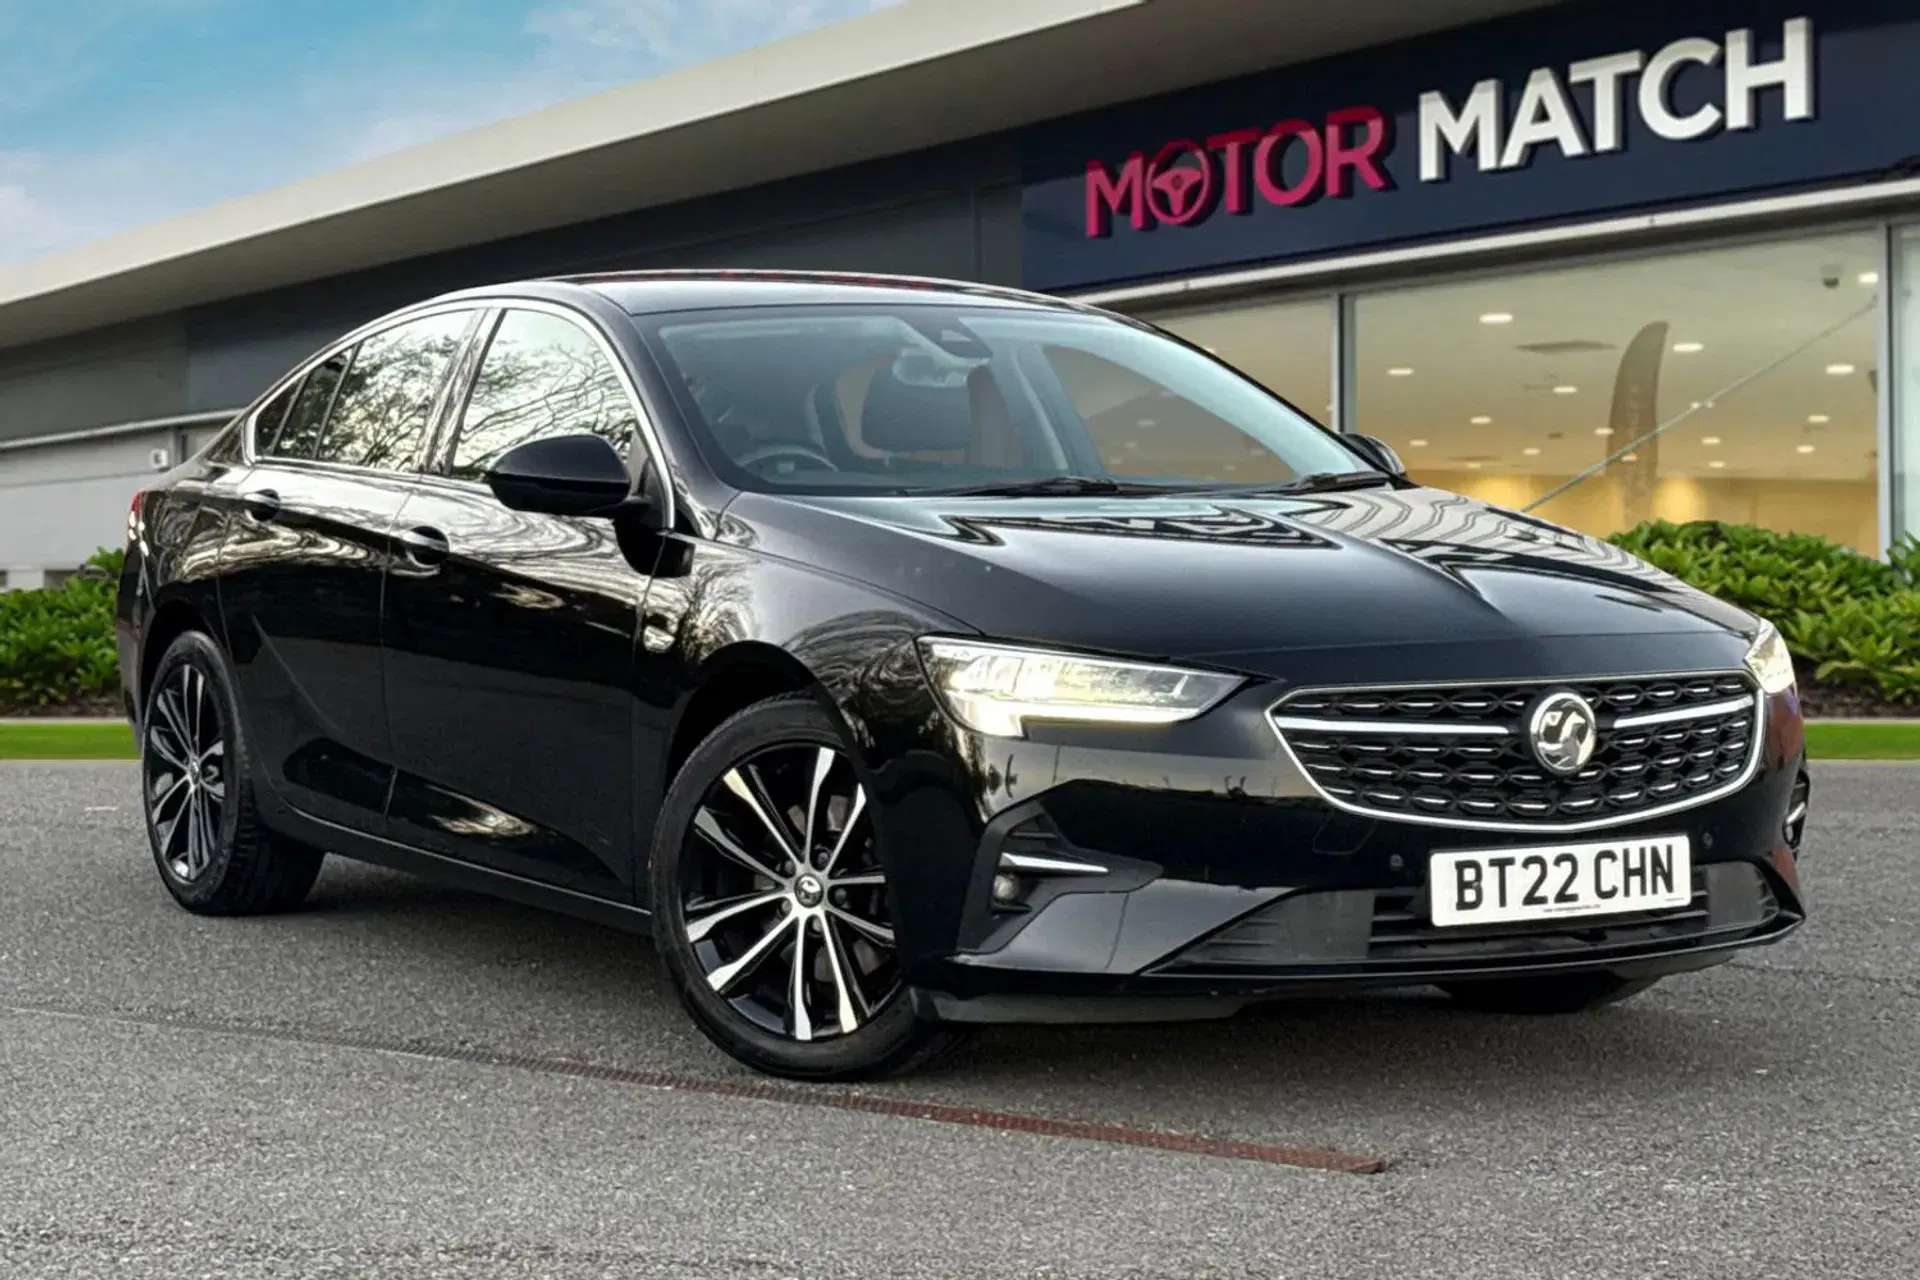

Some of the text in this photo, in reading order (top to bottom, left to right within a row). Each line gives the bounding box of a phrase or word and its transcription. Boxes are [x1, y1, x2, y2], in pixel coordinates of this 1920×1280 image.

[1086, 16, 1814, 237] MOTOR MATCH
[1454, 844, 1675, 911] BT22 CHN
